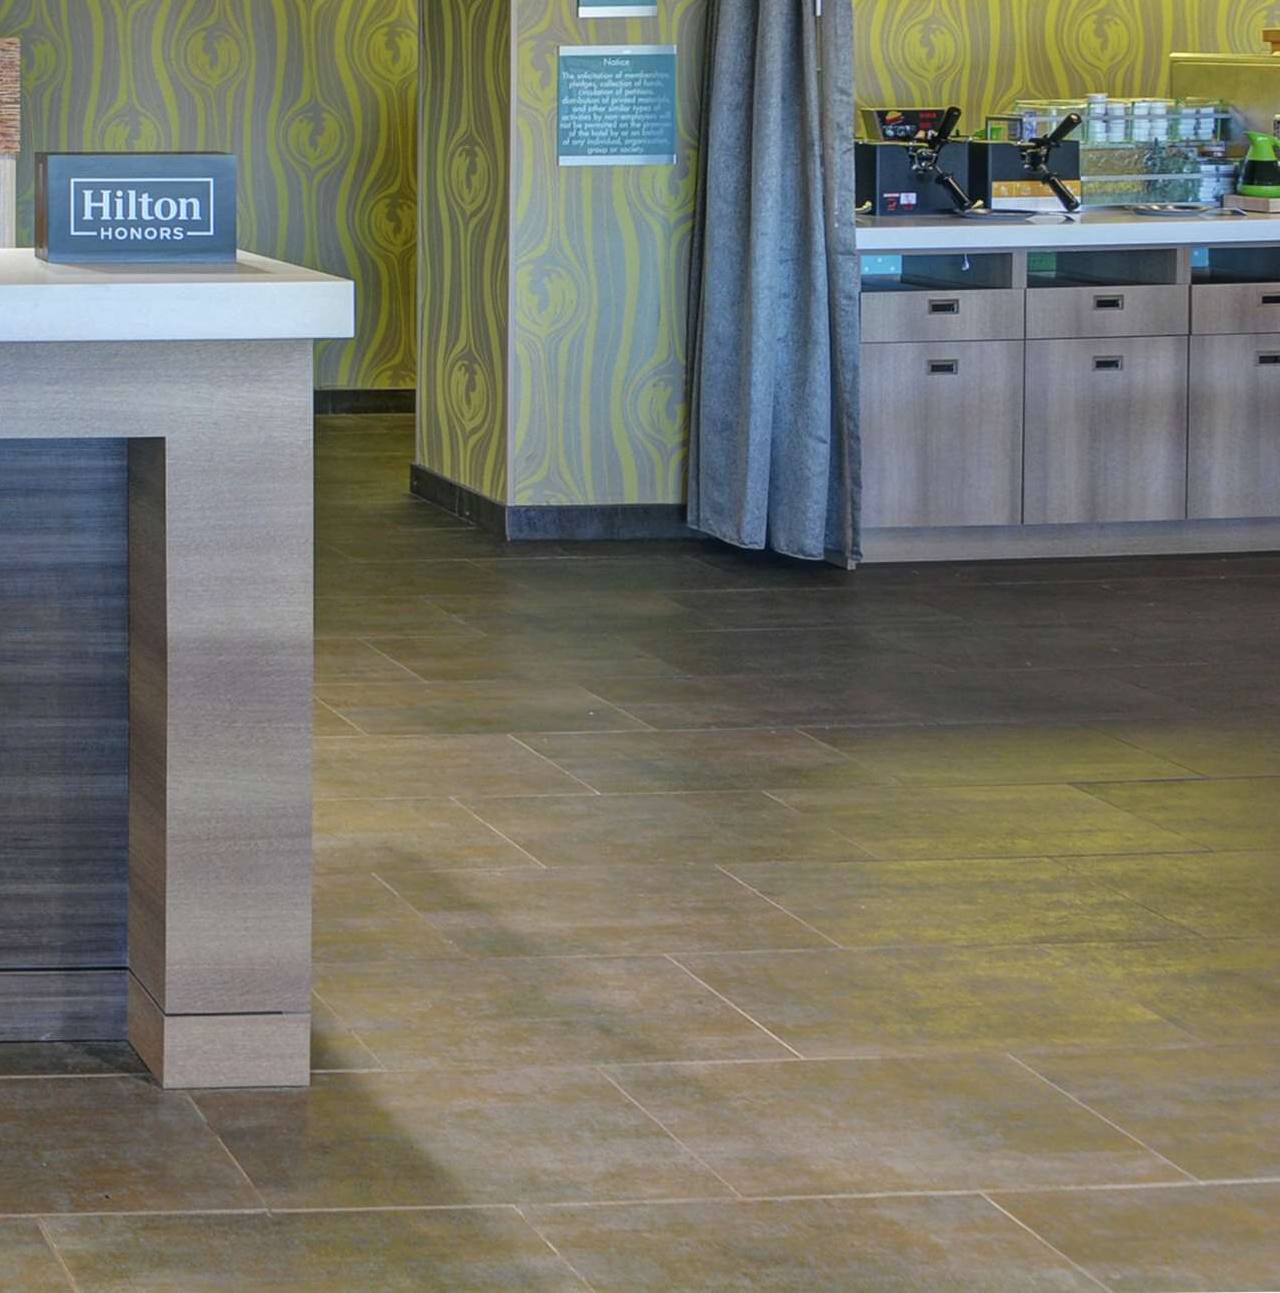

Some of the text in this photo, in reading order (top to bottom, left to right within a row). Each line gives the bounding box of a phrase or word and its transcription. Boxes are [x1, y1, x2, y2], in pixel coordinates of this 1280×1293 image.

[603, 58, 631, 67] Notice
[82, 189, 202, 222] Hilton
[100, 226, 185, 241] HONORS
